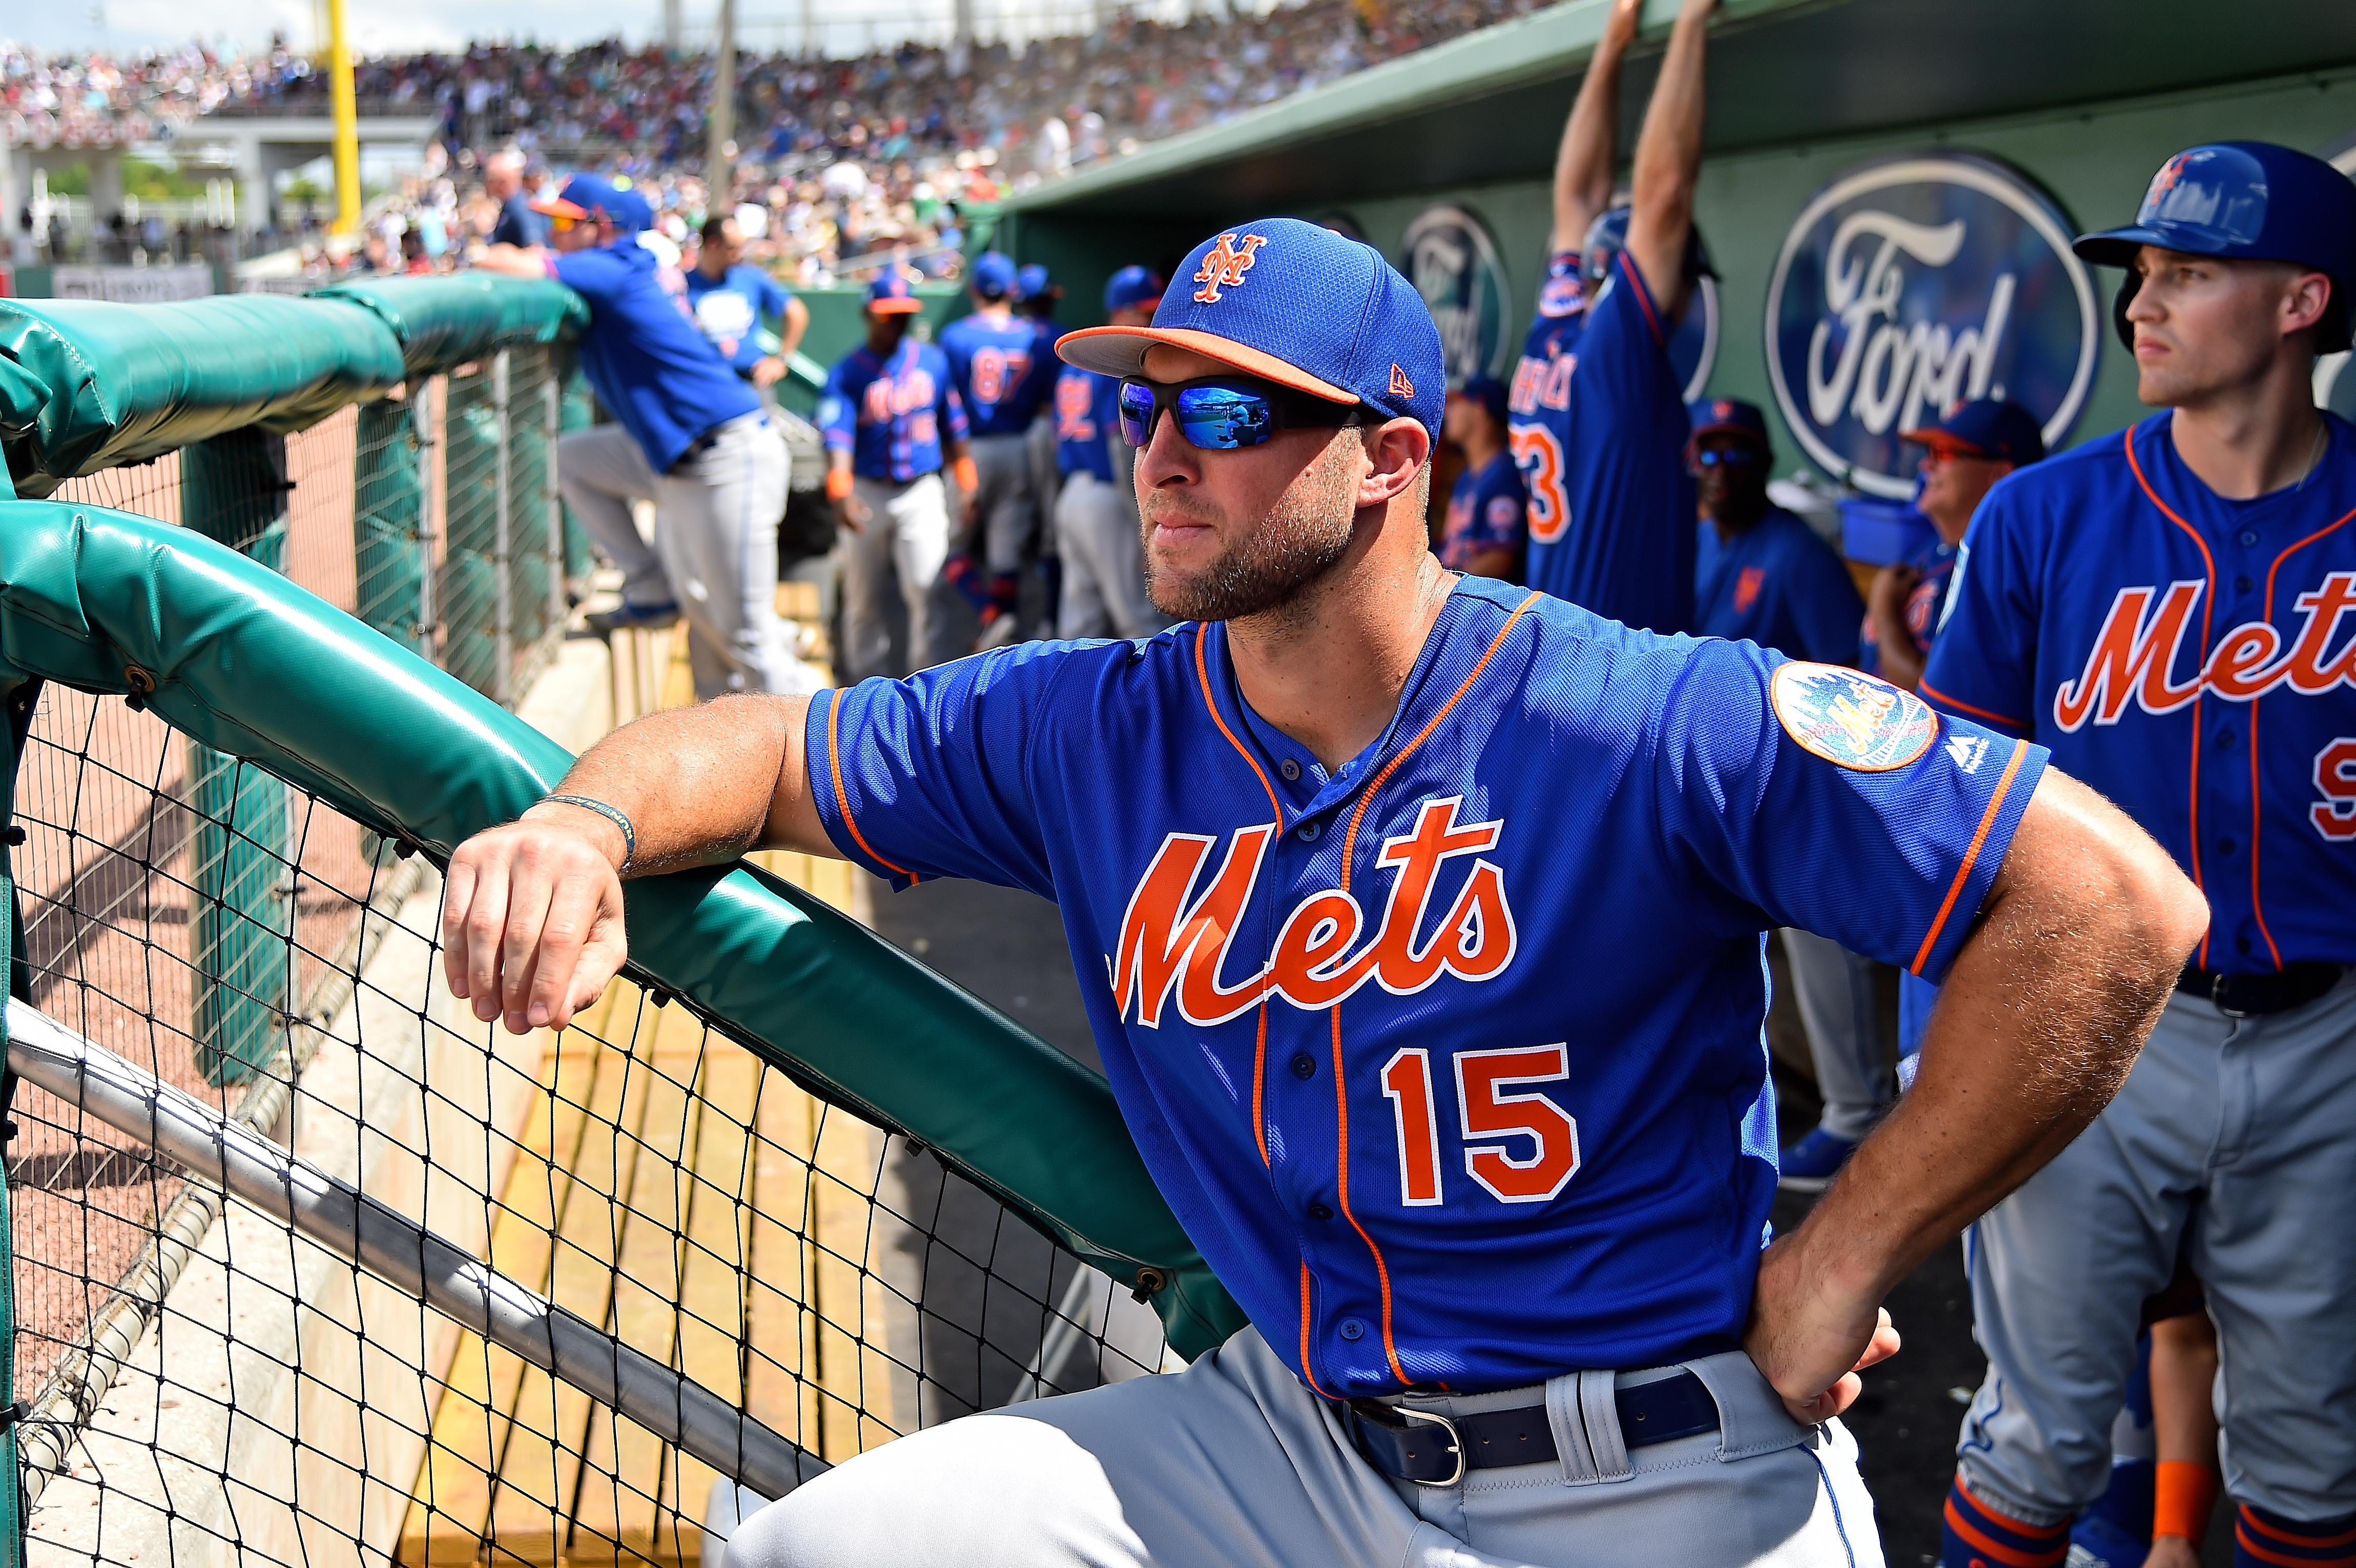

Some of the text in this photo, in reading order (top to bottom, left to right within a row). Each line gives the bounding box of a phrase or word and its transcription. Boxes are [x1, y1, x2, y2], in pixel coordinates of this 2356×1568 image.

[972, 346, 1034, 404] 87
[1807, 210, 2016, 436] Ford
[2053, 571, 2356, 734] Met
[1826, 682, 1897, 755] Mets
[1963, 738, 1989, 774] Majestic
[610, 810, 633, 840] RUN
[1105, 794, 1517, 1029] Mets
[1380, 1042, 1581, 1206] 15
